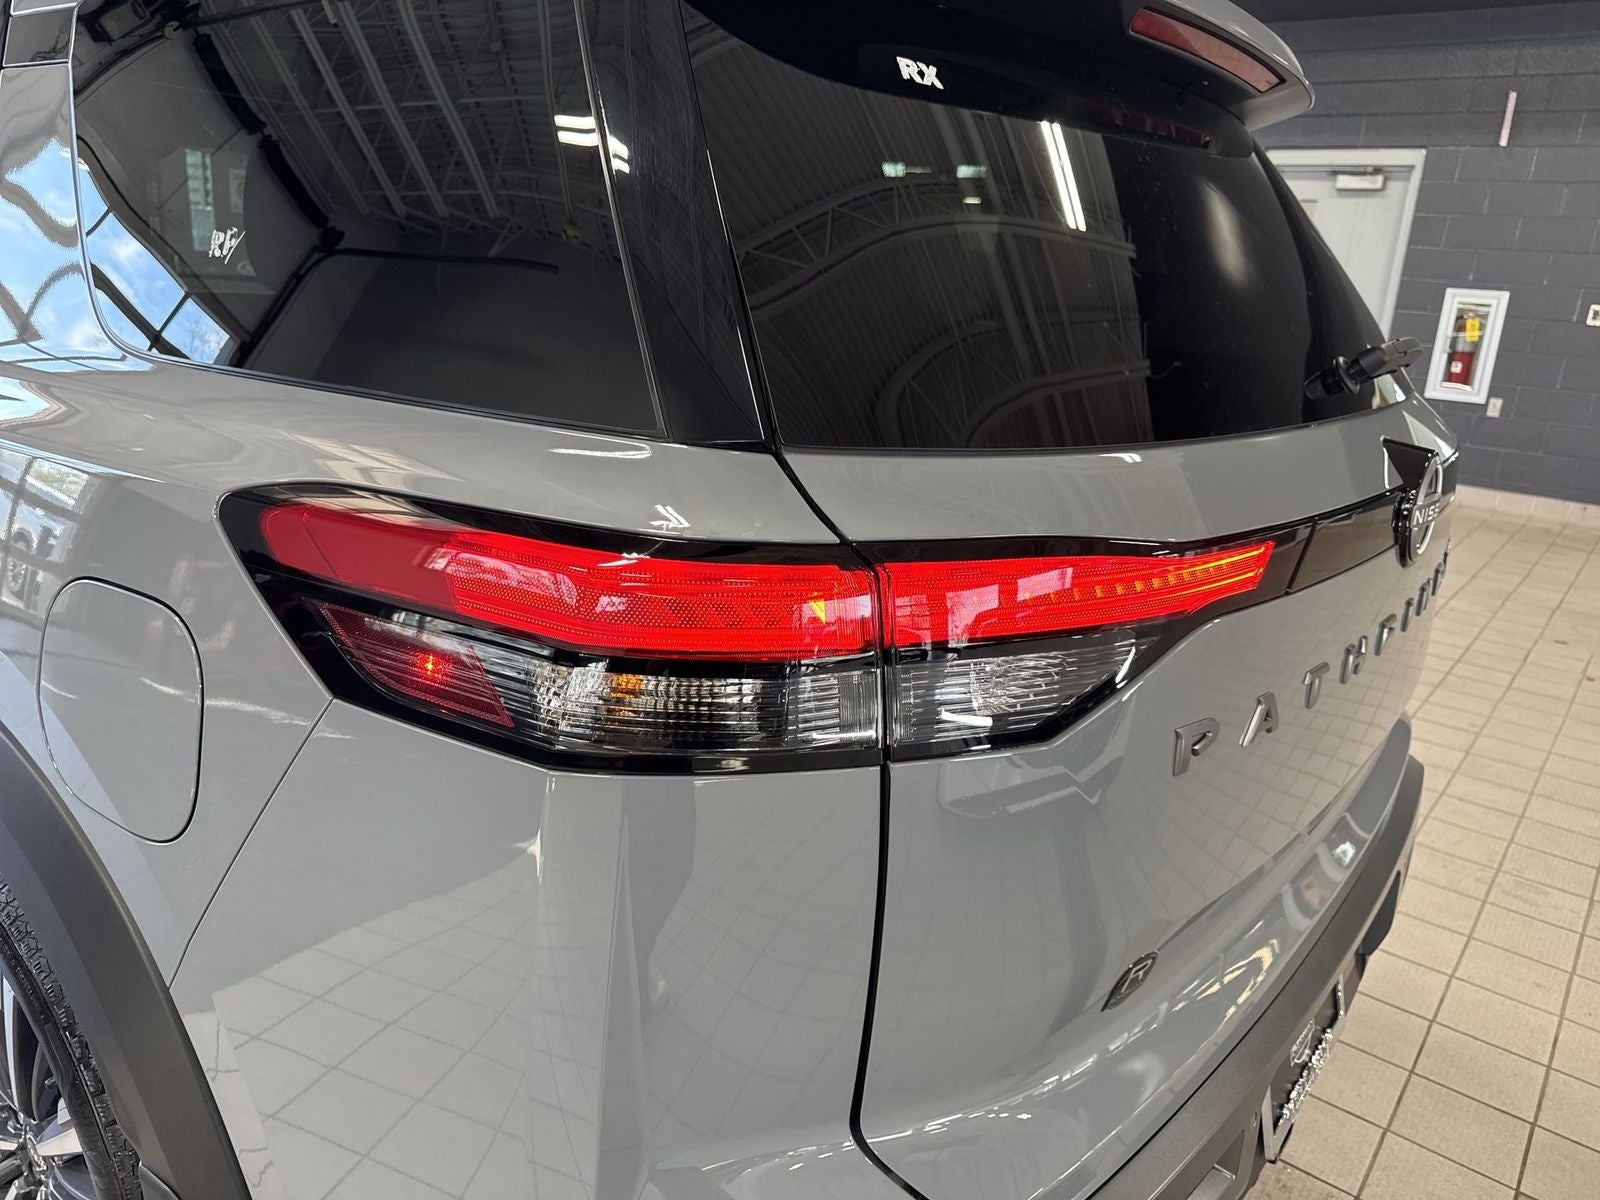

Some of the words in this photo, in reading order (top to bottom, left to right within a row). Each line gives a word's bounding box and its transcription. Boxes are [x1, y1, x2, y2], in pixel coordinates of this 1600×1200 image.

[896, 56, 944, 90] RX
[1413, 503, 1441, 524] NISS
[1172, 537, 1450, 776] PATHFIND
